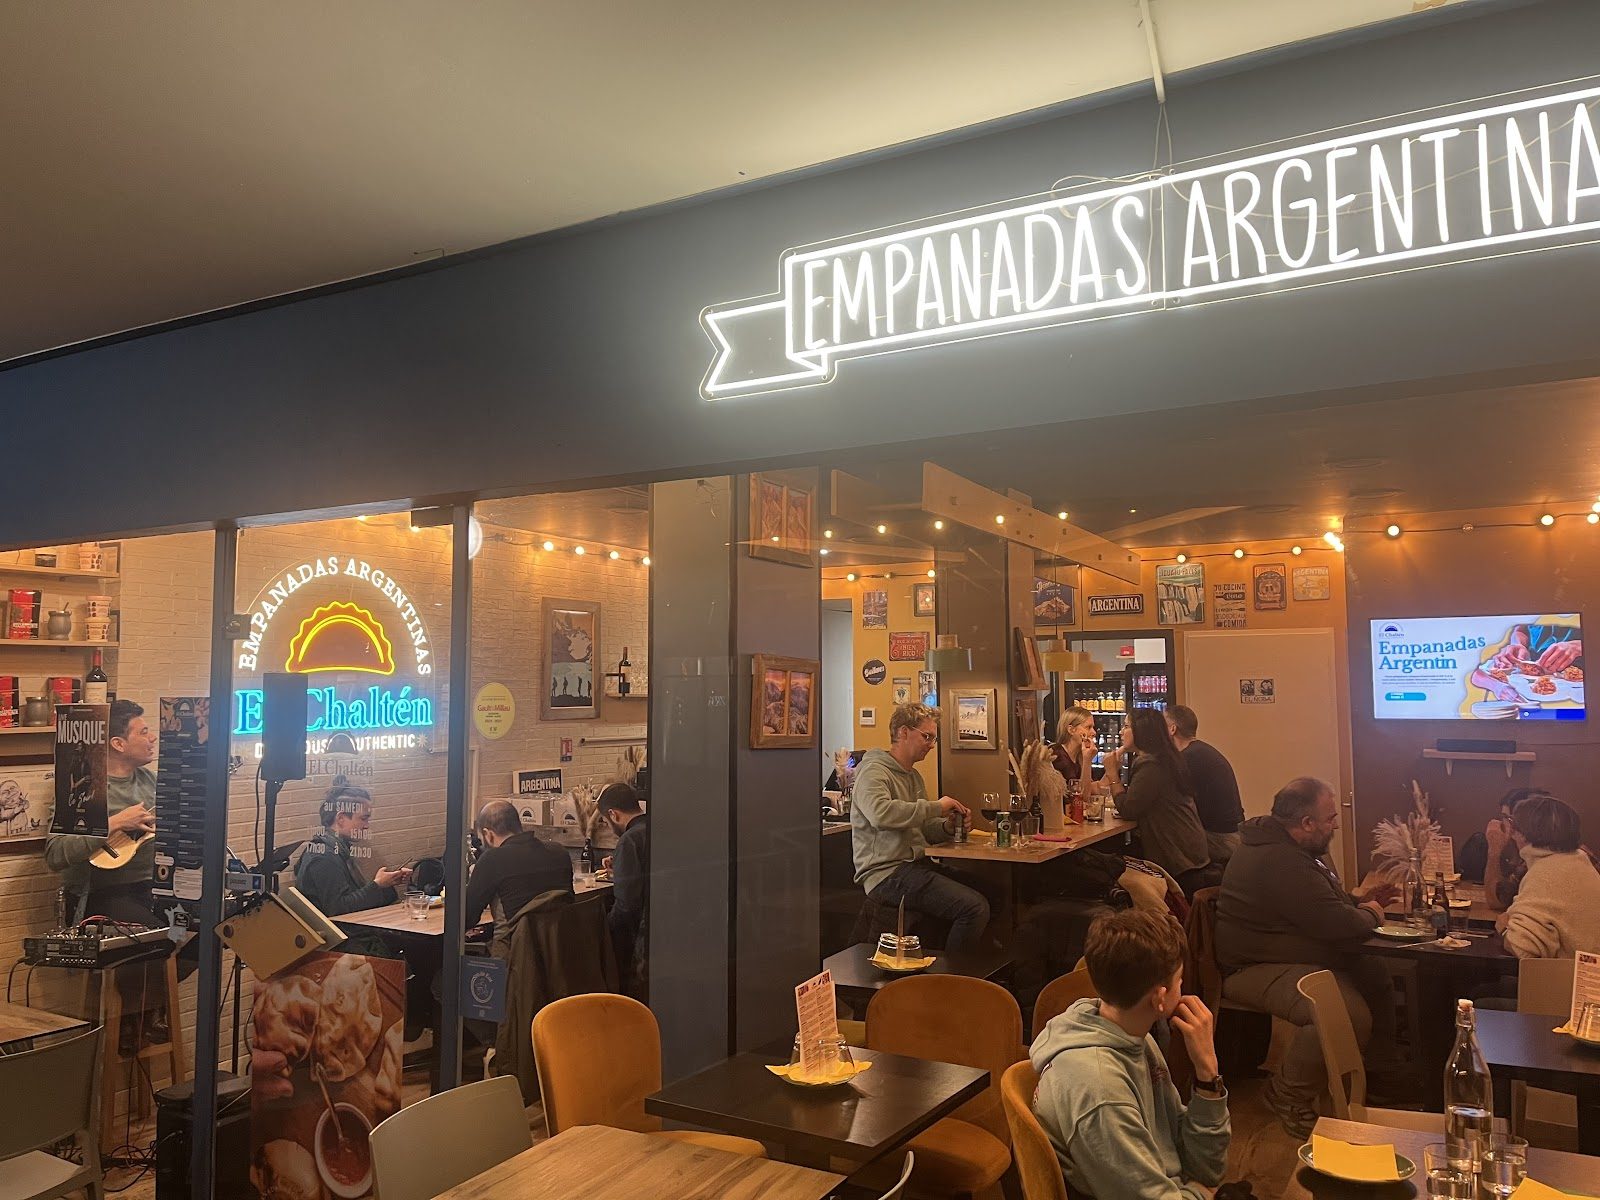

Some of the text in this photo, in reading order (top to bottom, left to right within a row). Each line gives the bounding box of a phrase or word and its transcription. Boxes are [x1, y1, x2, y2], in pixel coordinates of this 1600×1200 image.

[803, 102, 1600, 350] EMPANADAS ARGENTINA
[1090, 597, 1140, 612] ARGENTINA
[238, 556, 432, 676] EMPANADAS ARGENTINAS
[1378, 636, 1486, 658] Empanadas
[57, 720, 106, 744] MUSIQUE
[354, 733, 416, 751] UTHENTIC
[308, 760, 374, 777] El Chaltén
[520, 777, 561, 792] ARGENTINA
[323, 801, 363, 814] au SAMEDI
[349, 845, 372, 859] 21h30
